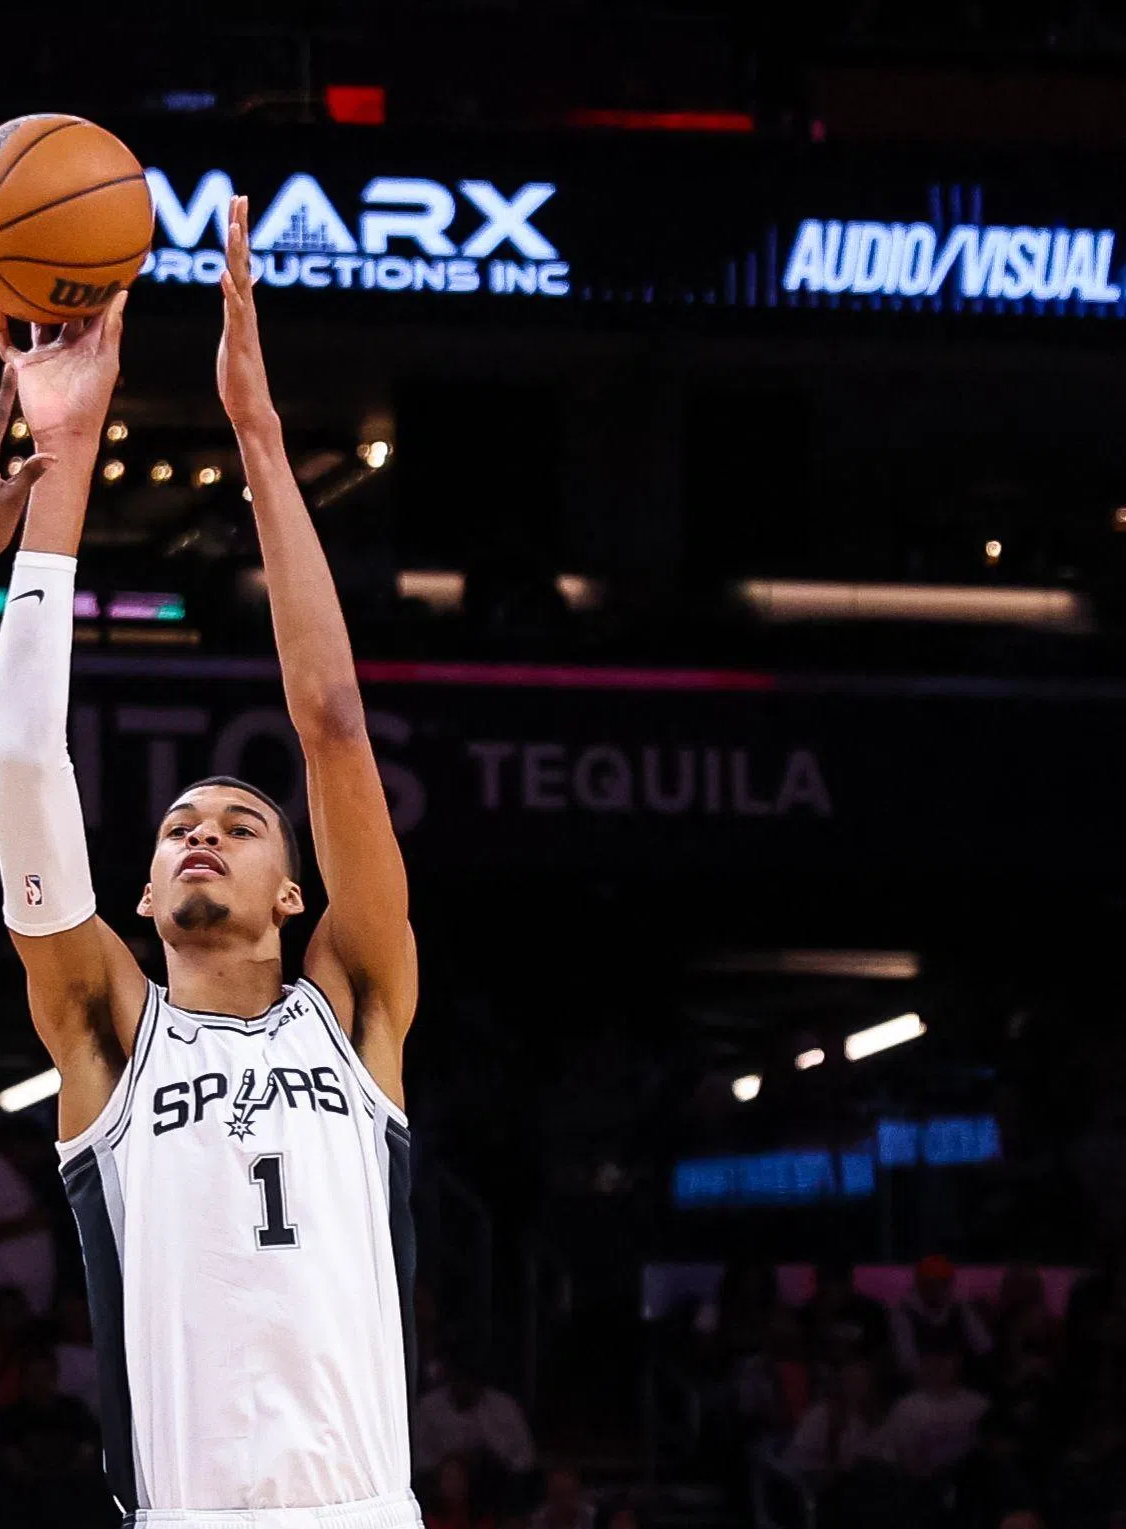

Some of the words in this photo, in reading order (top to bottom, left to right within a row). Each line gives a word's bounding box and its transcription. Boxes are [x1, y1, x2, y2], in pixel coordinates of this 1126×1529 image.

[143, 167, 560, 261] MARX
[488, 260, 572, 297] INC
[781, 218, 1123, 303] AUDIO/VISUAL
[465, 737, 834, 819] TEQUILA
[152, 1065, 350, 1143] SPURS
[248, 1151, 301, 1250] 1
